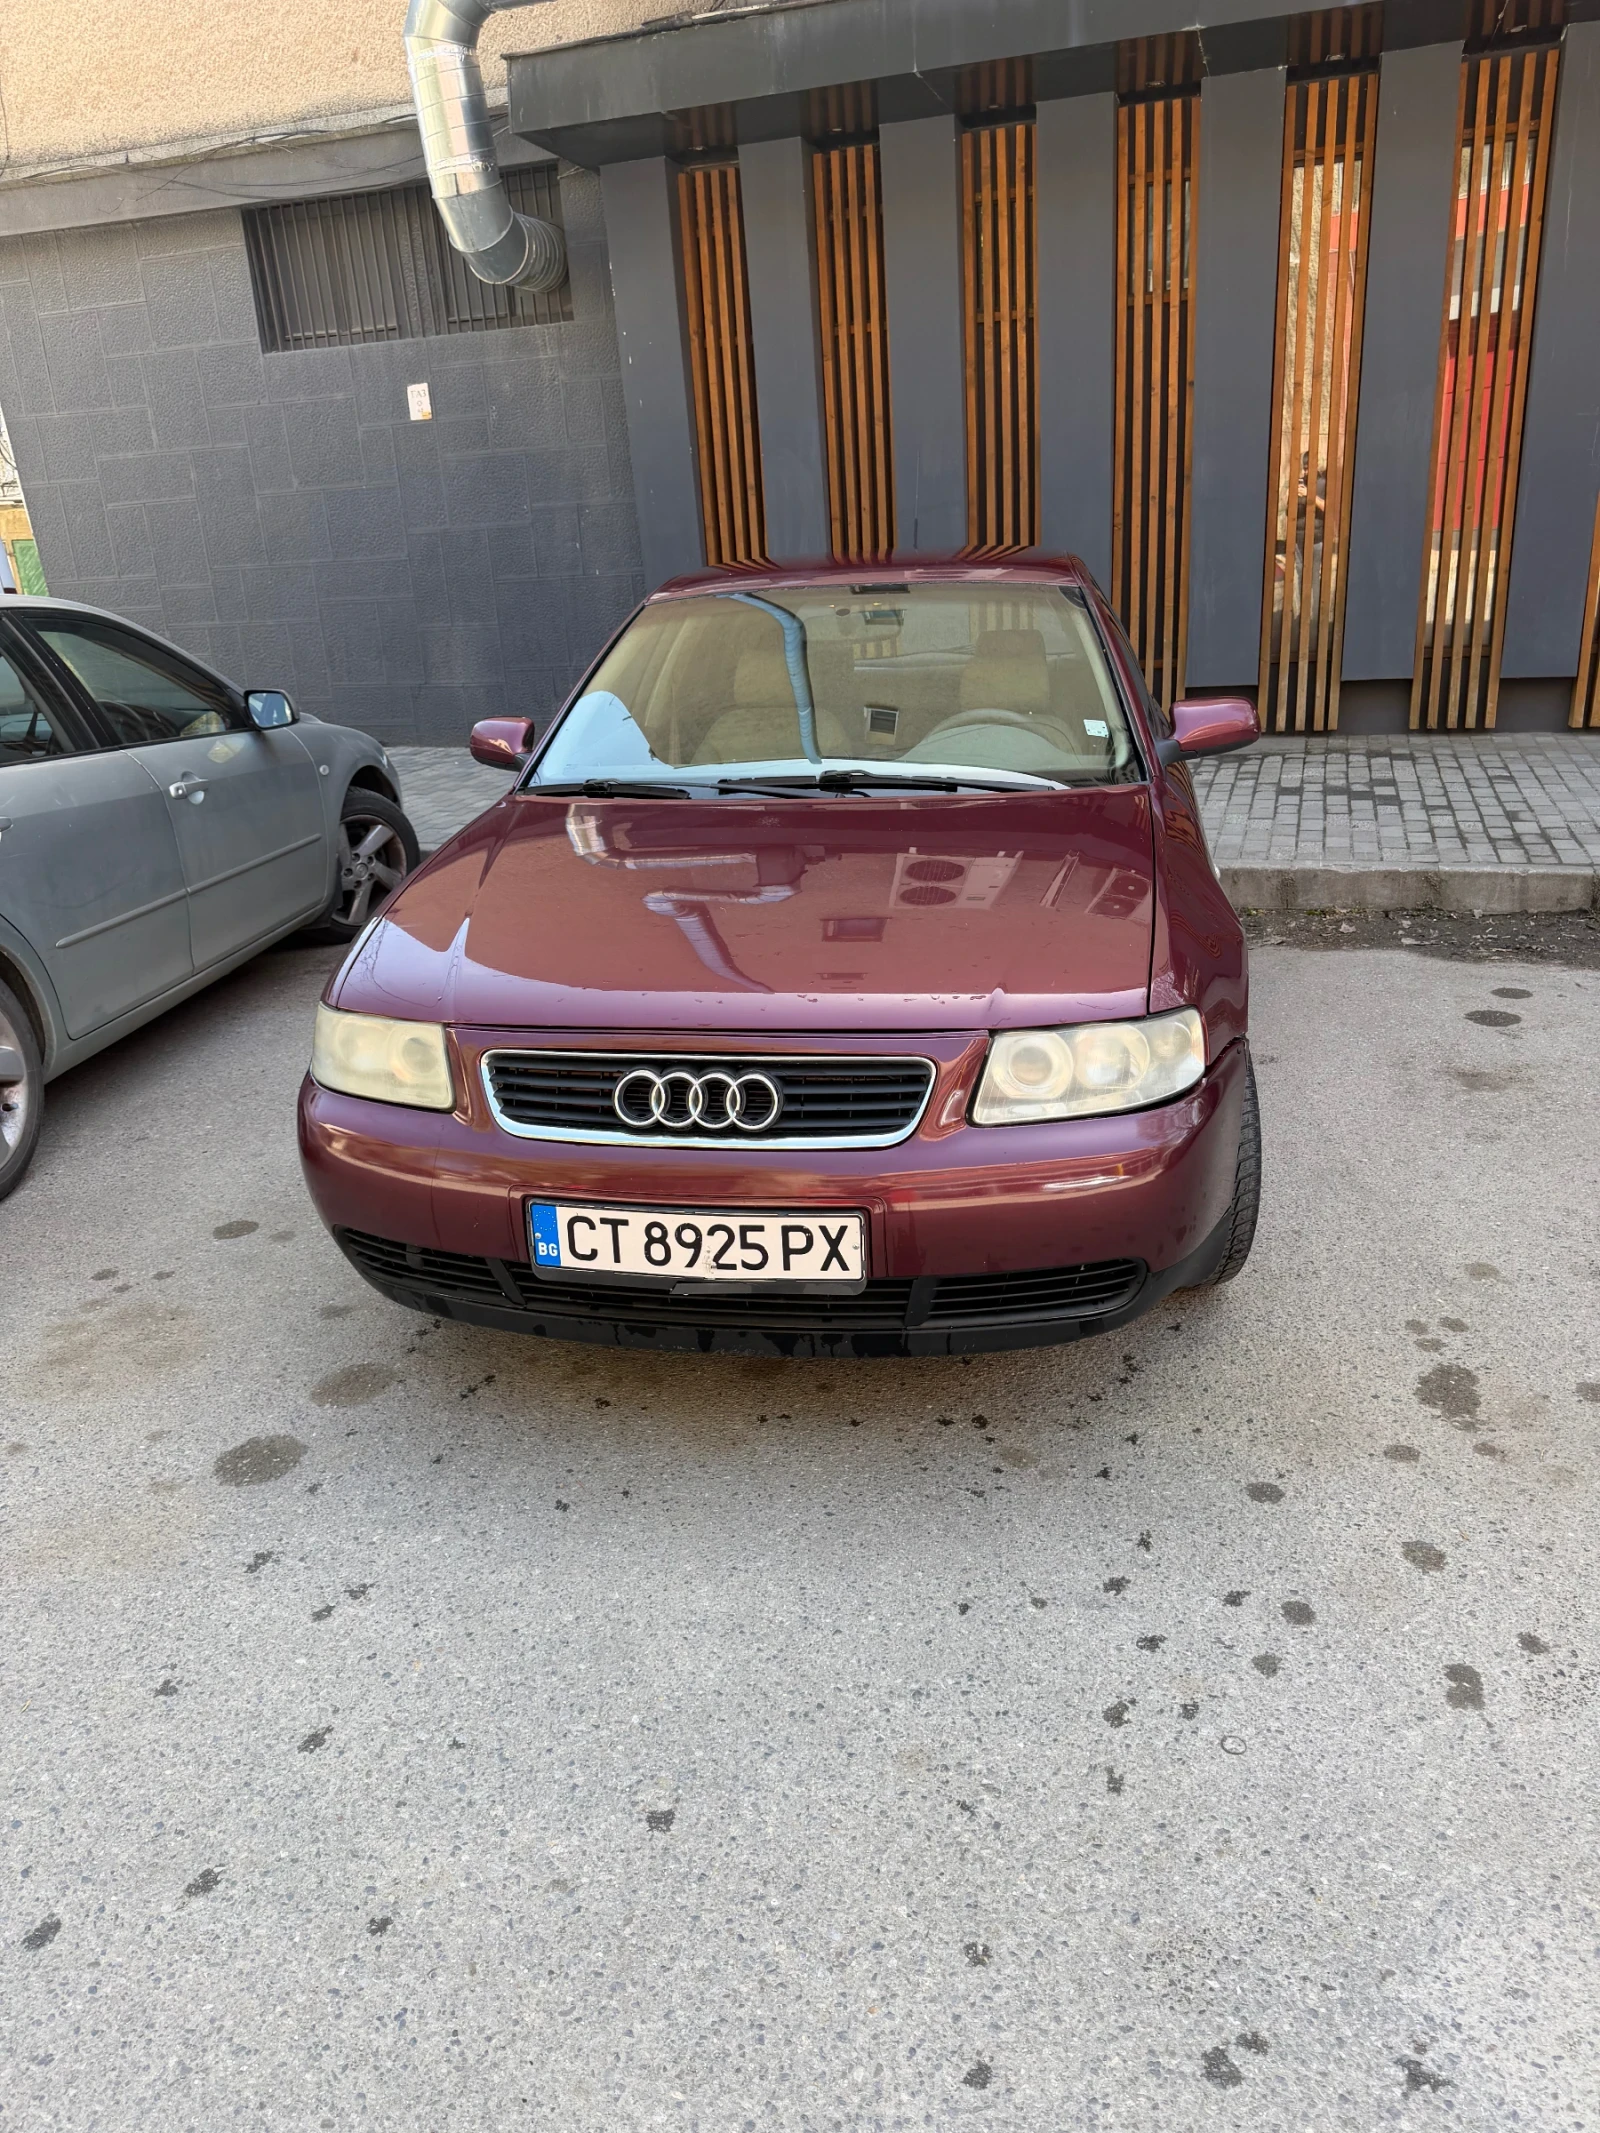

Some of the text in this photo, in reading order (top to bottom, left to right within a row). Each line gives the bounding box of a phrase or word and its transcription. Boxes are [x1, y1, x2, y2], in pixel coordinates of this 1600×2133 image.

[538, 1215, 850, 1272] BG CT 8925 PX
